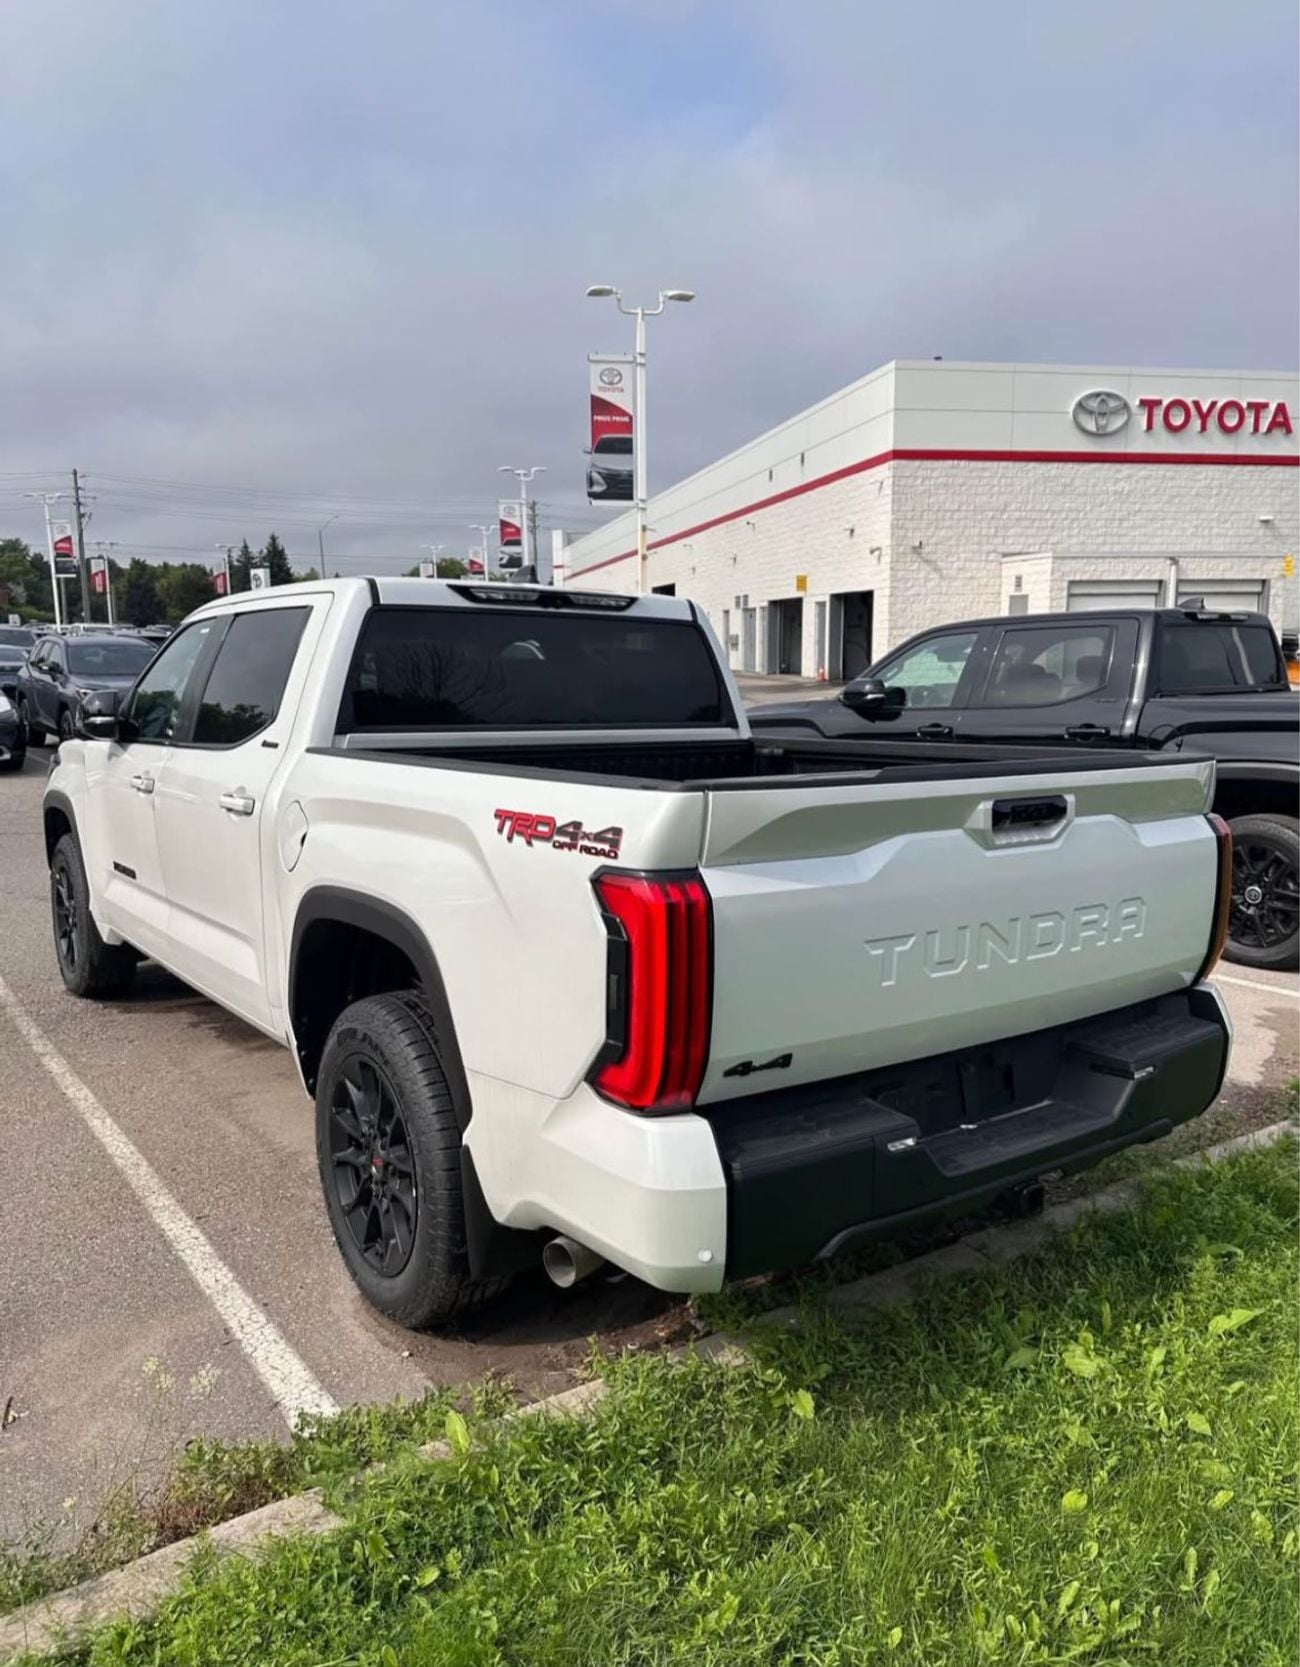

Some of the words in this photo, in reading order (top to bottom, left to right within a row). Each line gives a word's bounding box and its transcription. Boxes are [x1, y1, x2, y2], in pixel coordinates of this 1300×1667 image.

[1138, 398, 1293, 435] TOYOTA
[494, 808, 556, 847] TRD
[552, 840, 578, 851] OFF
[579, 844, 619, 860] ROAD
[864, 896, 1146, 986] TUNDRA
